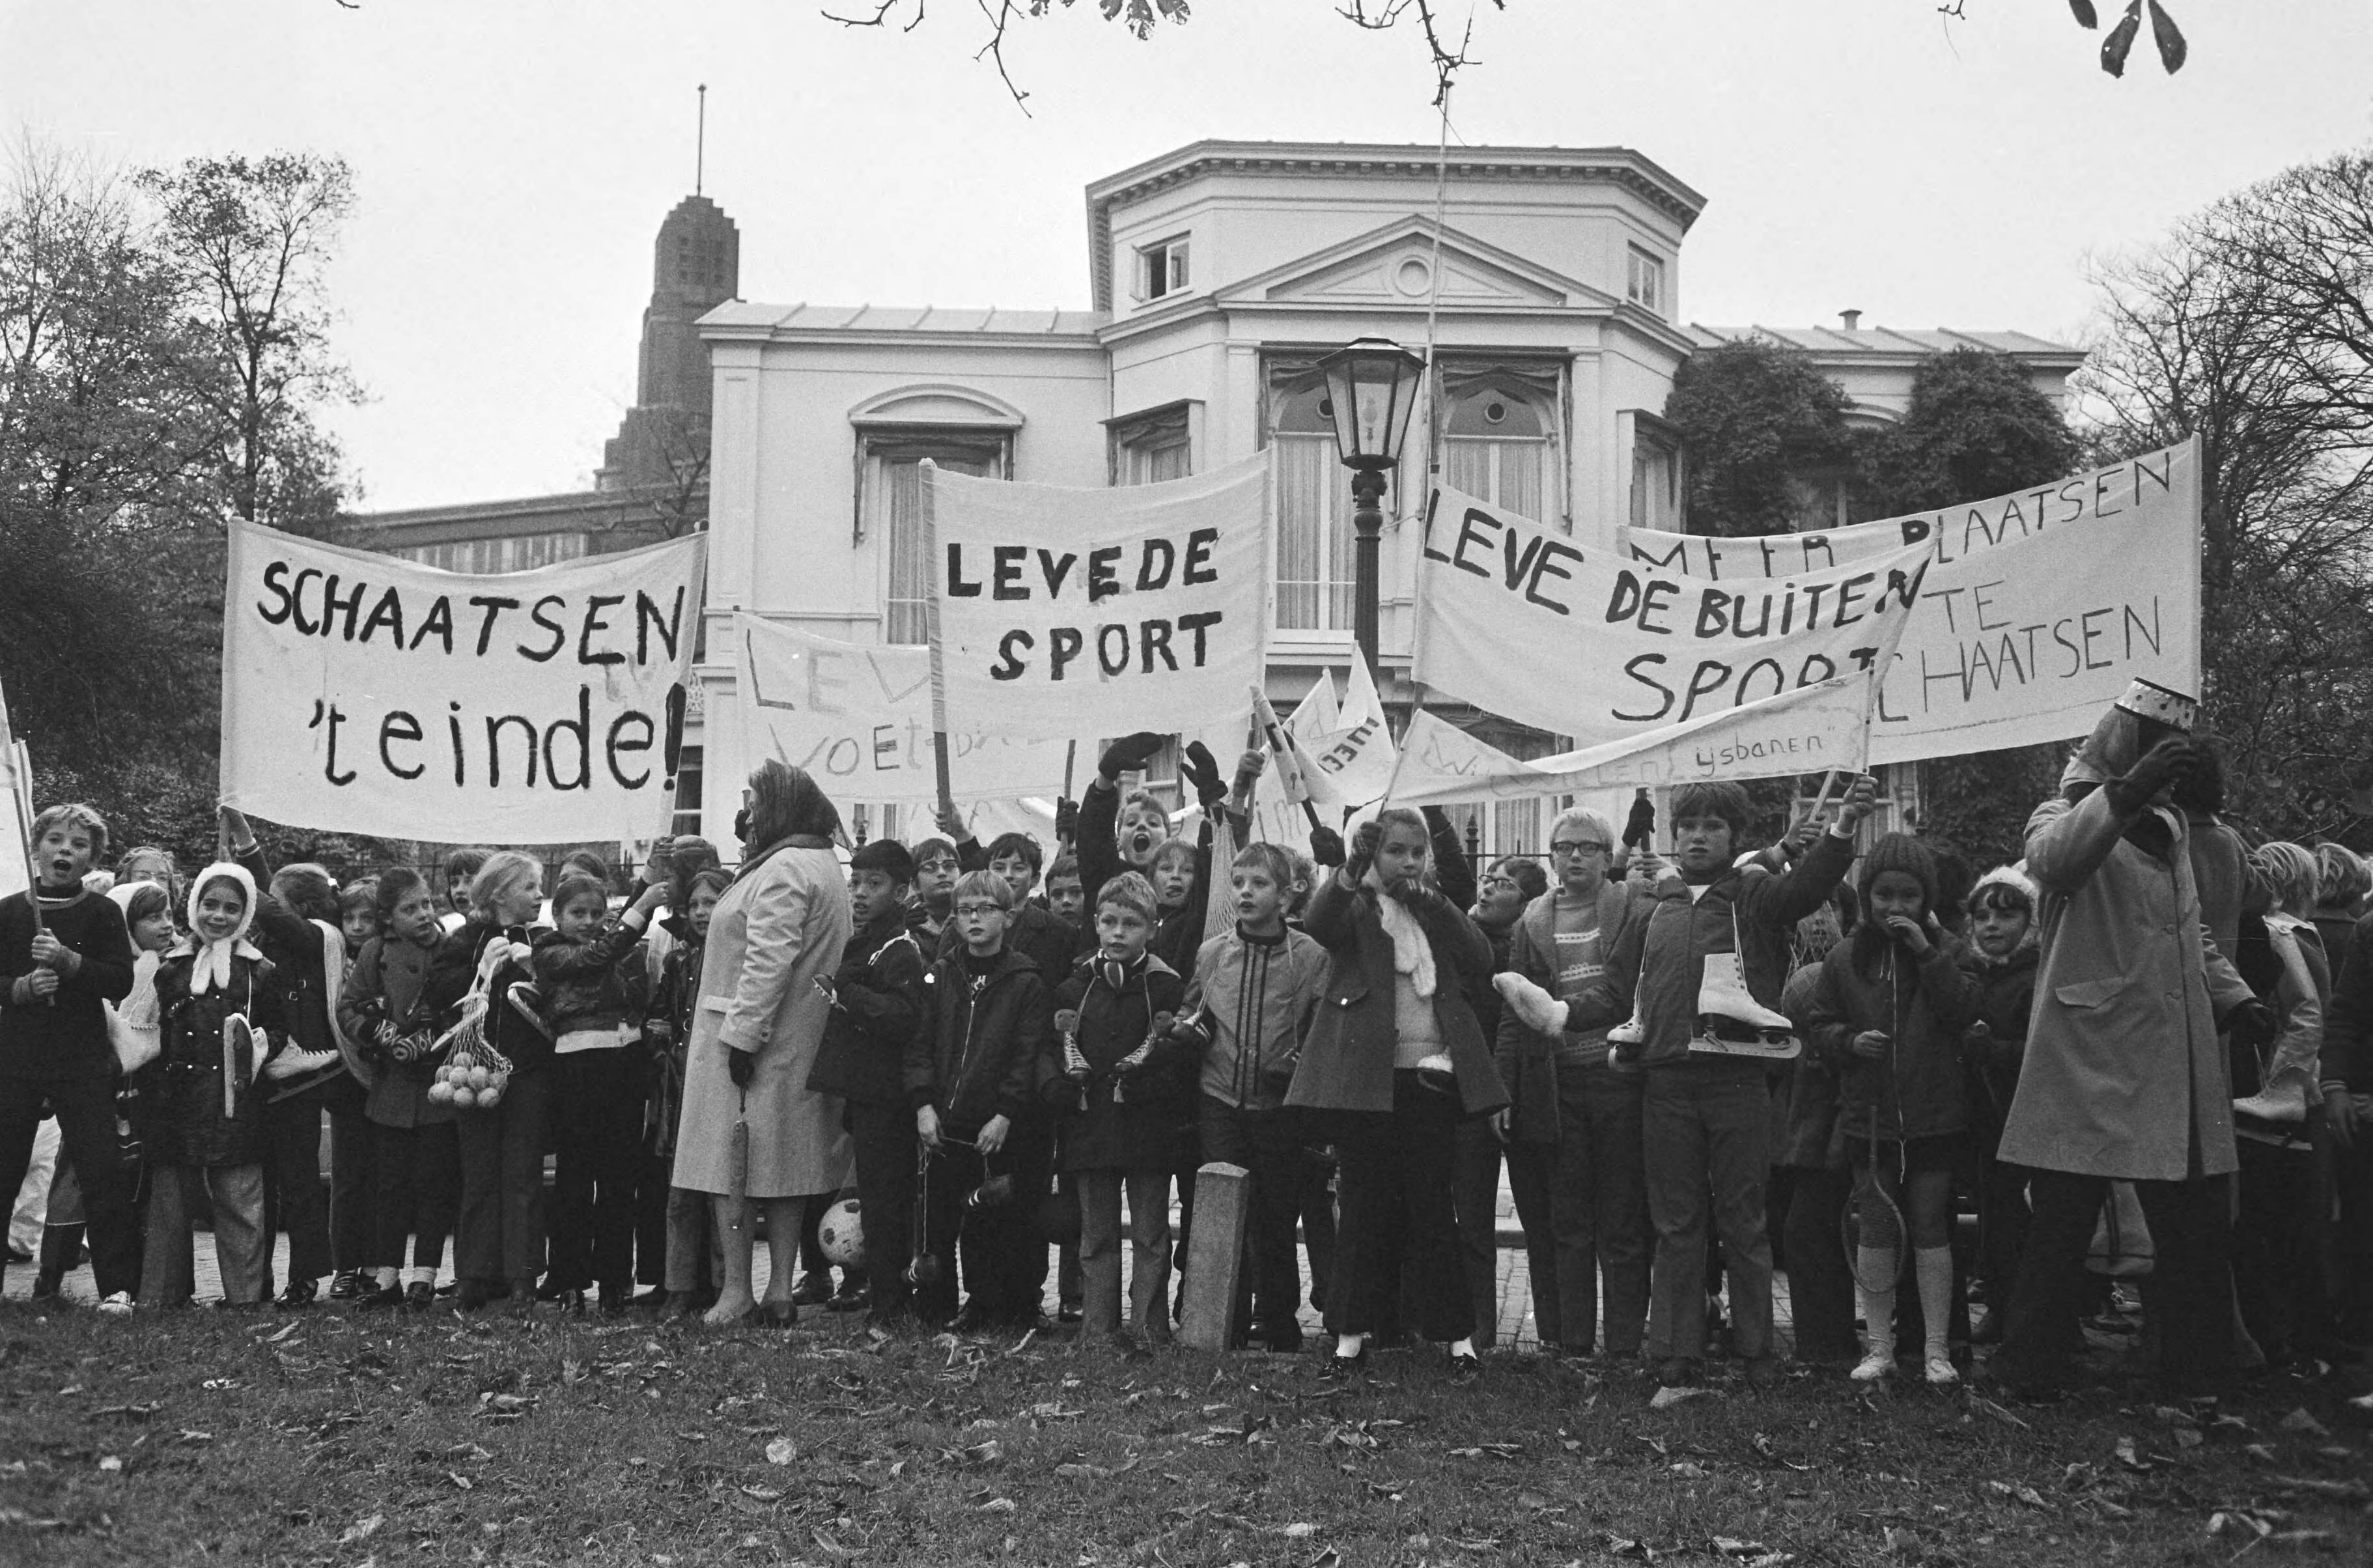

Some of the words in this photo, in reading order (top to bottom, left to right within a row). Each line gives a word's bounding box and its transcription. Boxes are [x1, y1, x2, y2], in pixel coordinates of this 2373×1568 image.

[257, 561, 685, 665] SCHAATSEN
[1424, 488, 1584, 615] LEVE
[1606, 570, 1681, 634] DE
[1922, 580, 2013, 634] TE
[990, 611, 1223, 681] SPORT
[1878, 595, 2160, 723] CHAATSEN
[380, 682, 686, 791] einde!
